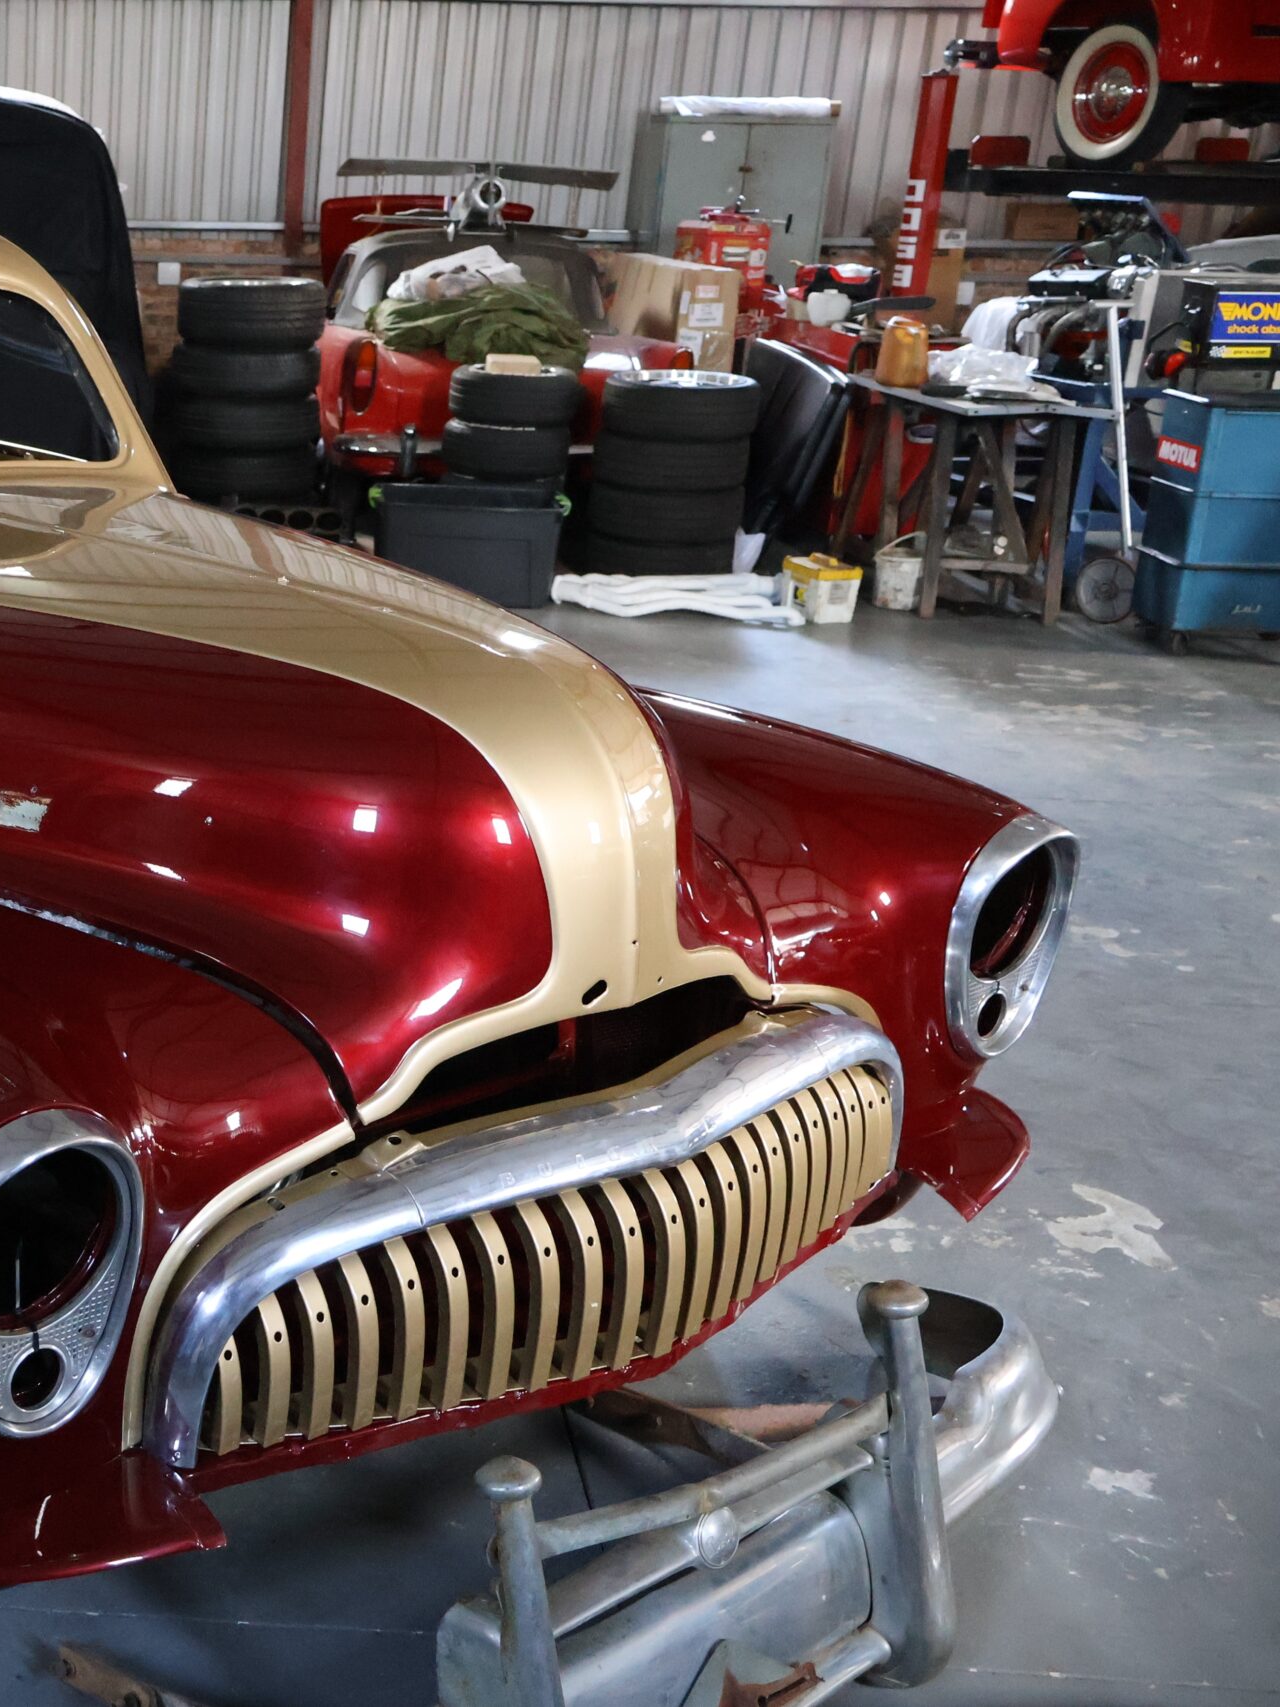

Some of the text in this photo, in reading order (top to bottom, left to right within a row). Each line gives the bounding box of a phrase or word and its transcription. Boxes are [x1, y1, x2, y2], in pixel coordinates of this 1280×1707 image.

[1218, 302, 1280, 321] MON
[1227, 323, 1259, 334] shock
[1158, 440, 1197, 468] MOTUL
